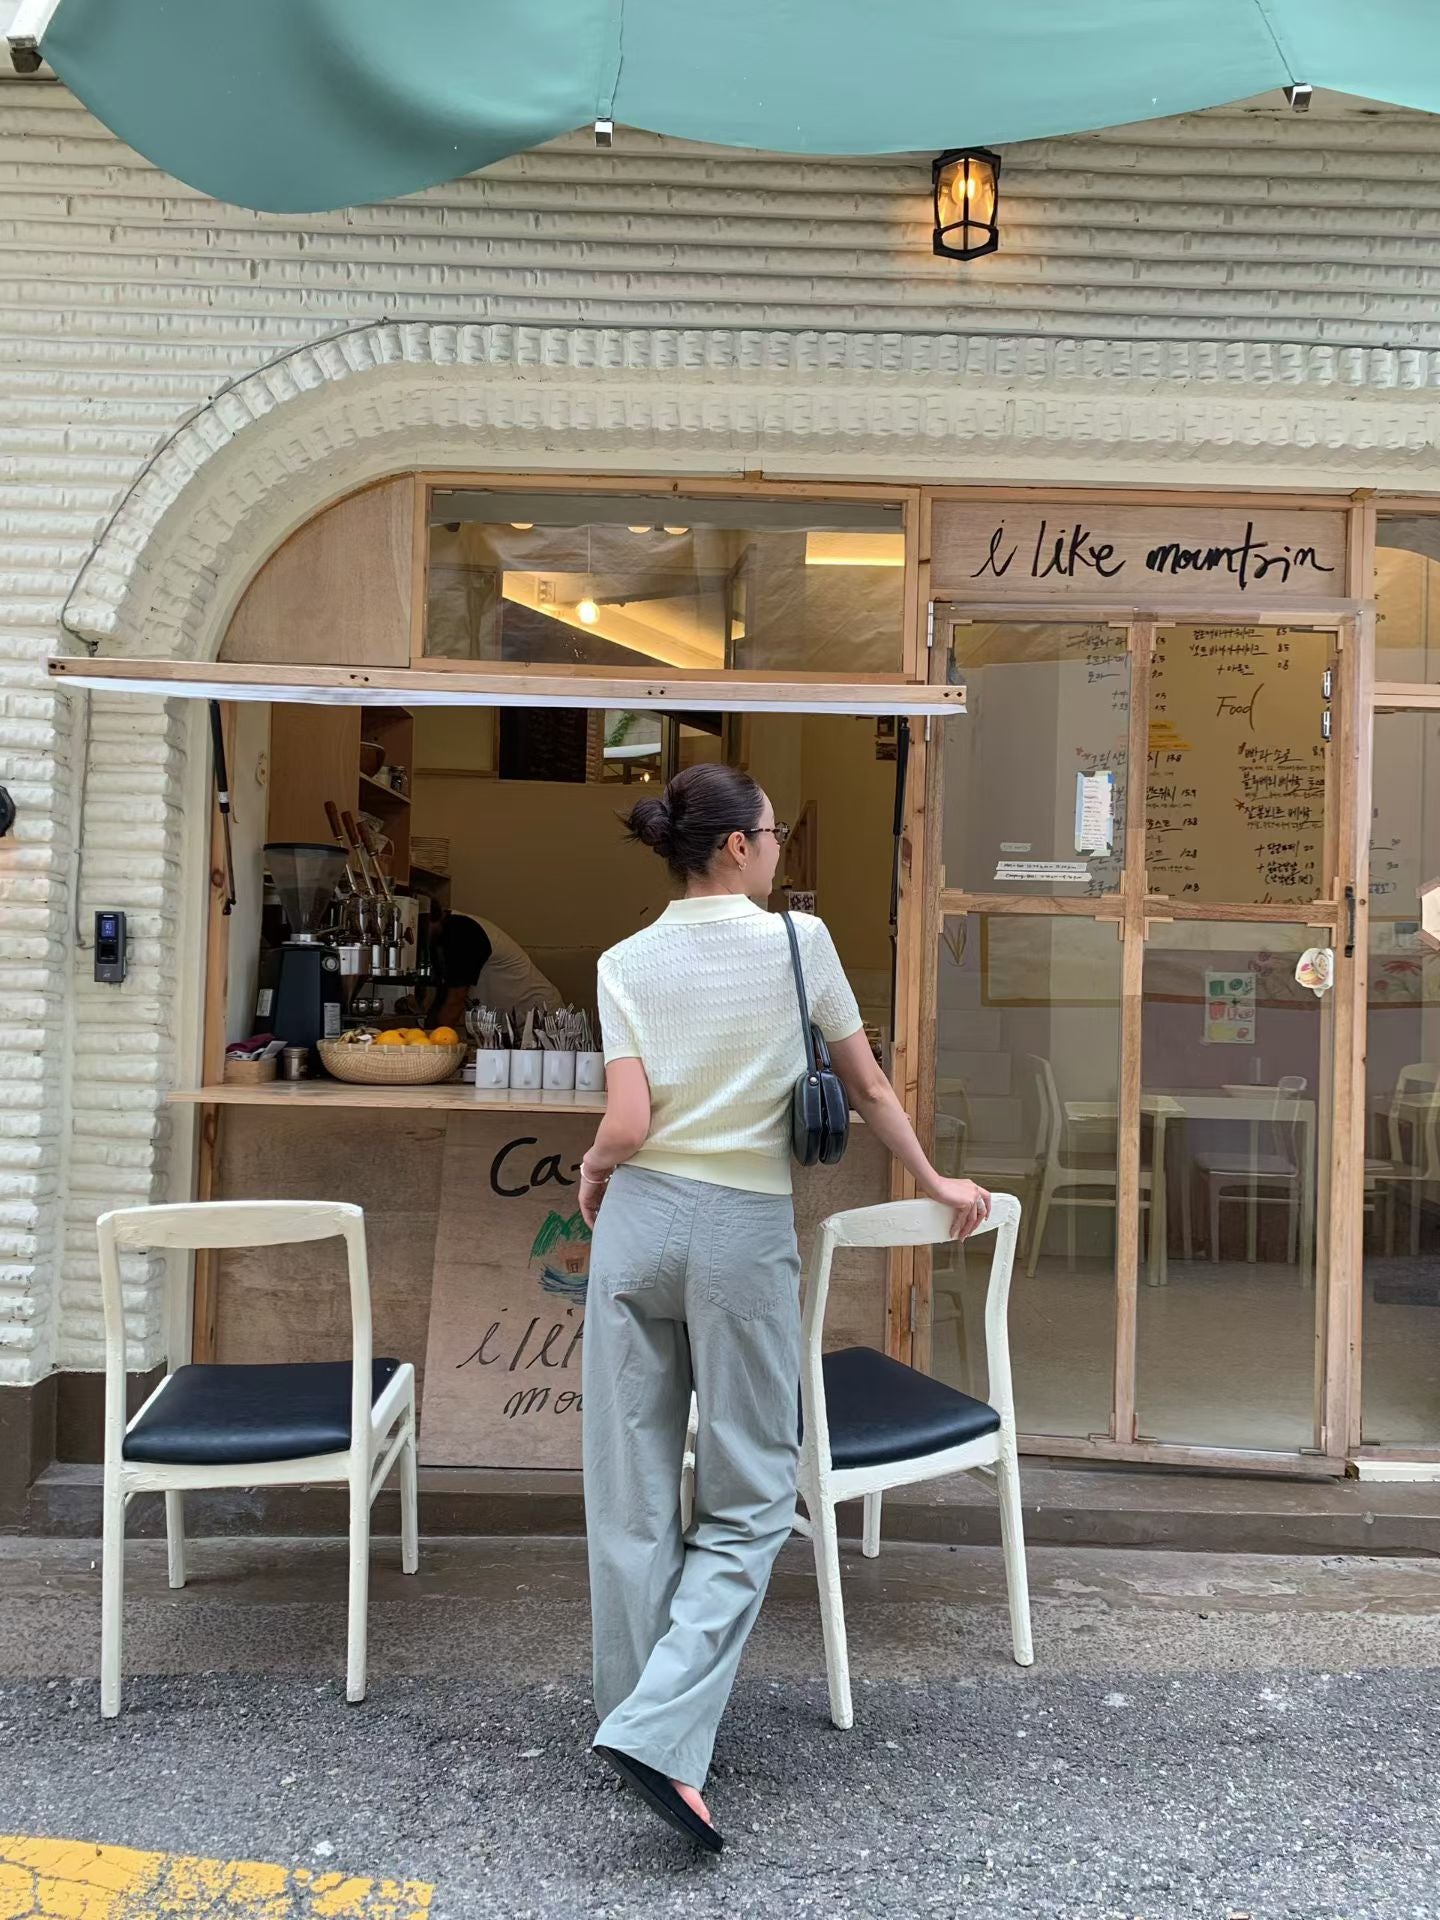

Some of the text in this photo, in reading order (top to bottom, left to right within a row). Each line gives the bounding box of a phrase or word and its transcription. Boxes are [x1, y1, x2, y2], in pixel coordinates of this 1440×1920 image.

[970, 519, 1017, 577] i
[1031, 520, 1126, 577] like
[1216, 682, 1265, 733] Food
[490, 1136, 582, 1197] Ca
